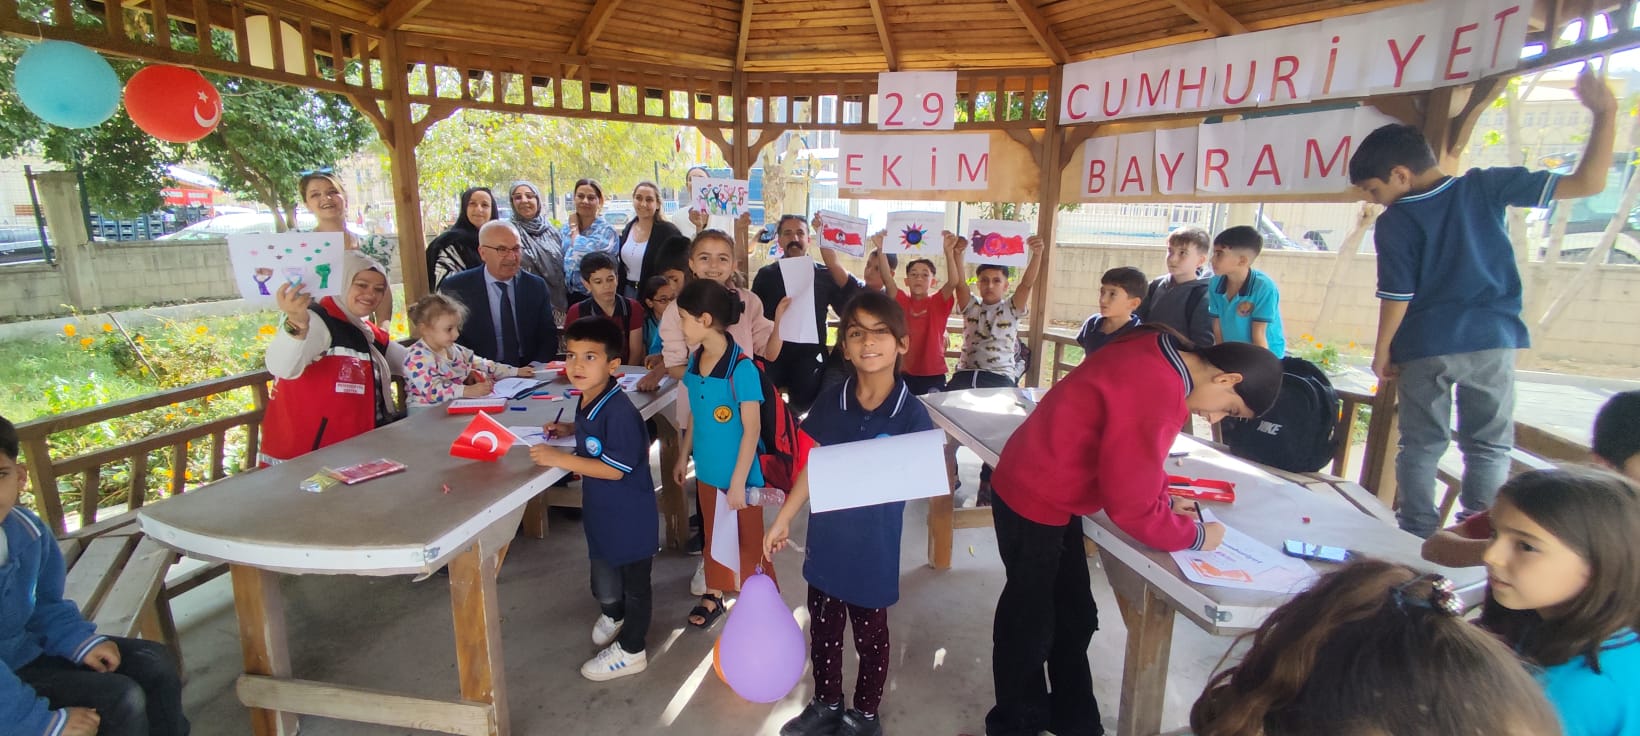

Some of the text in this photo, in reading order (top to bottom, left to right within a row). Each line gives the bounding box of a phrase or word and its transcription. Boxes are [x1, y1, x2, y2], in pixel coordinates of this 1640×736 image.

[884, 92, 944, 126] 29
[846, 147, 989, 186] EKİM
[1088, 136, 1351, 193] BAYRAM
